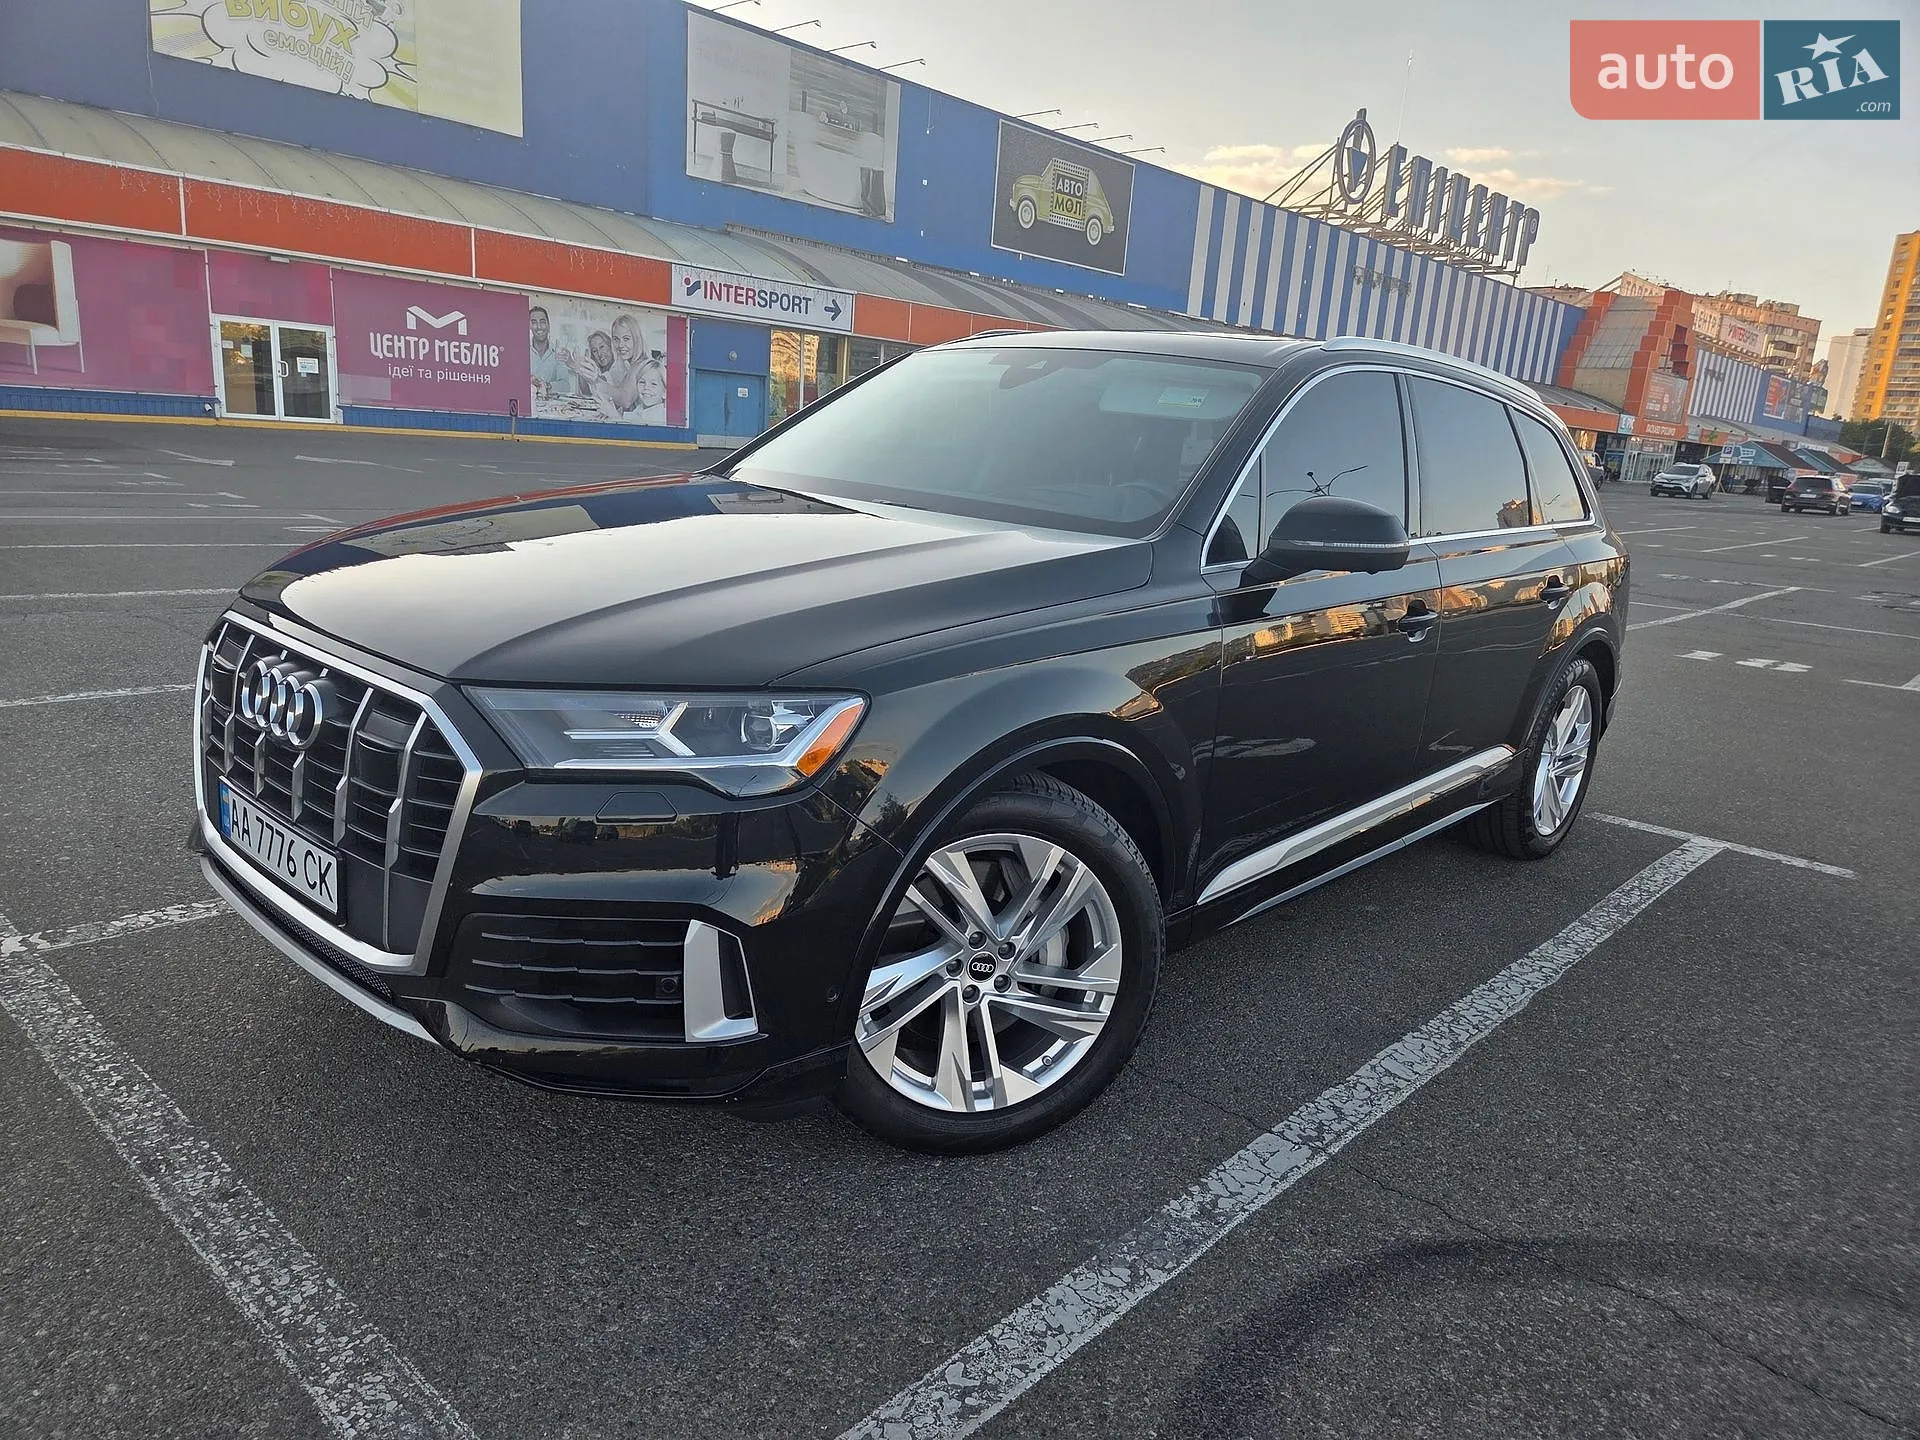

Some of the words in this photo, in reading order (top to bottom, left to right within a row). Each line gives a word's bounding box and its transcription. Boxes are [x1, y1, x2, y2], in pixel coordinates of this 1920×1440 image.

[263, 29, 354, 84] емоцій!
[1056, 177, 1083, 197] АВТО
[1054, 195, 1082, 216] МОЛ
[703, 279, 812, 315] INTERSPORT
[369, 331, 430, 361] ЦЕНТР
[434, 339, 500, 368] МЕБЛІВ
[388, 363, 414, 379] ідеї
[417, 367, 432, 379] та
[437, 368, 491, 385] рішення
[231, 798, 252, 848] AA
[255, 816, 297, 878] 7776
[303, 849, 334, 903] CK
